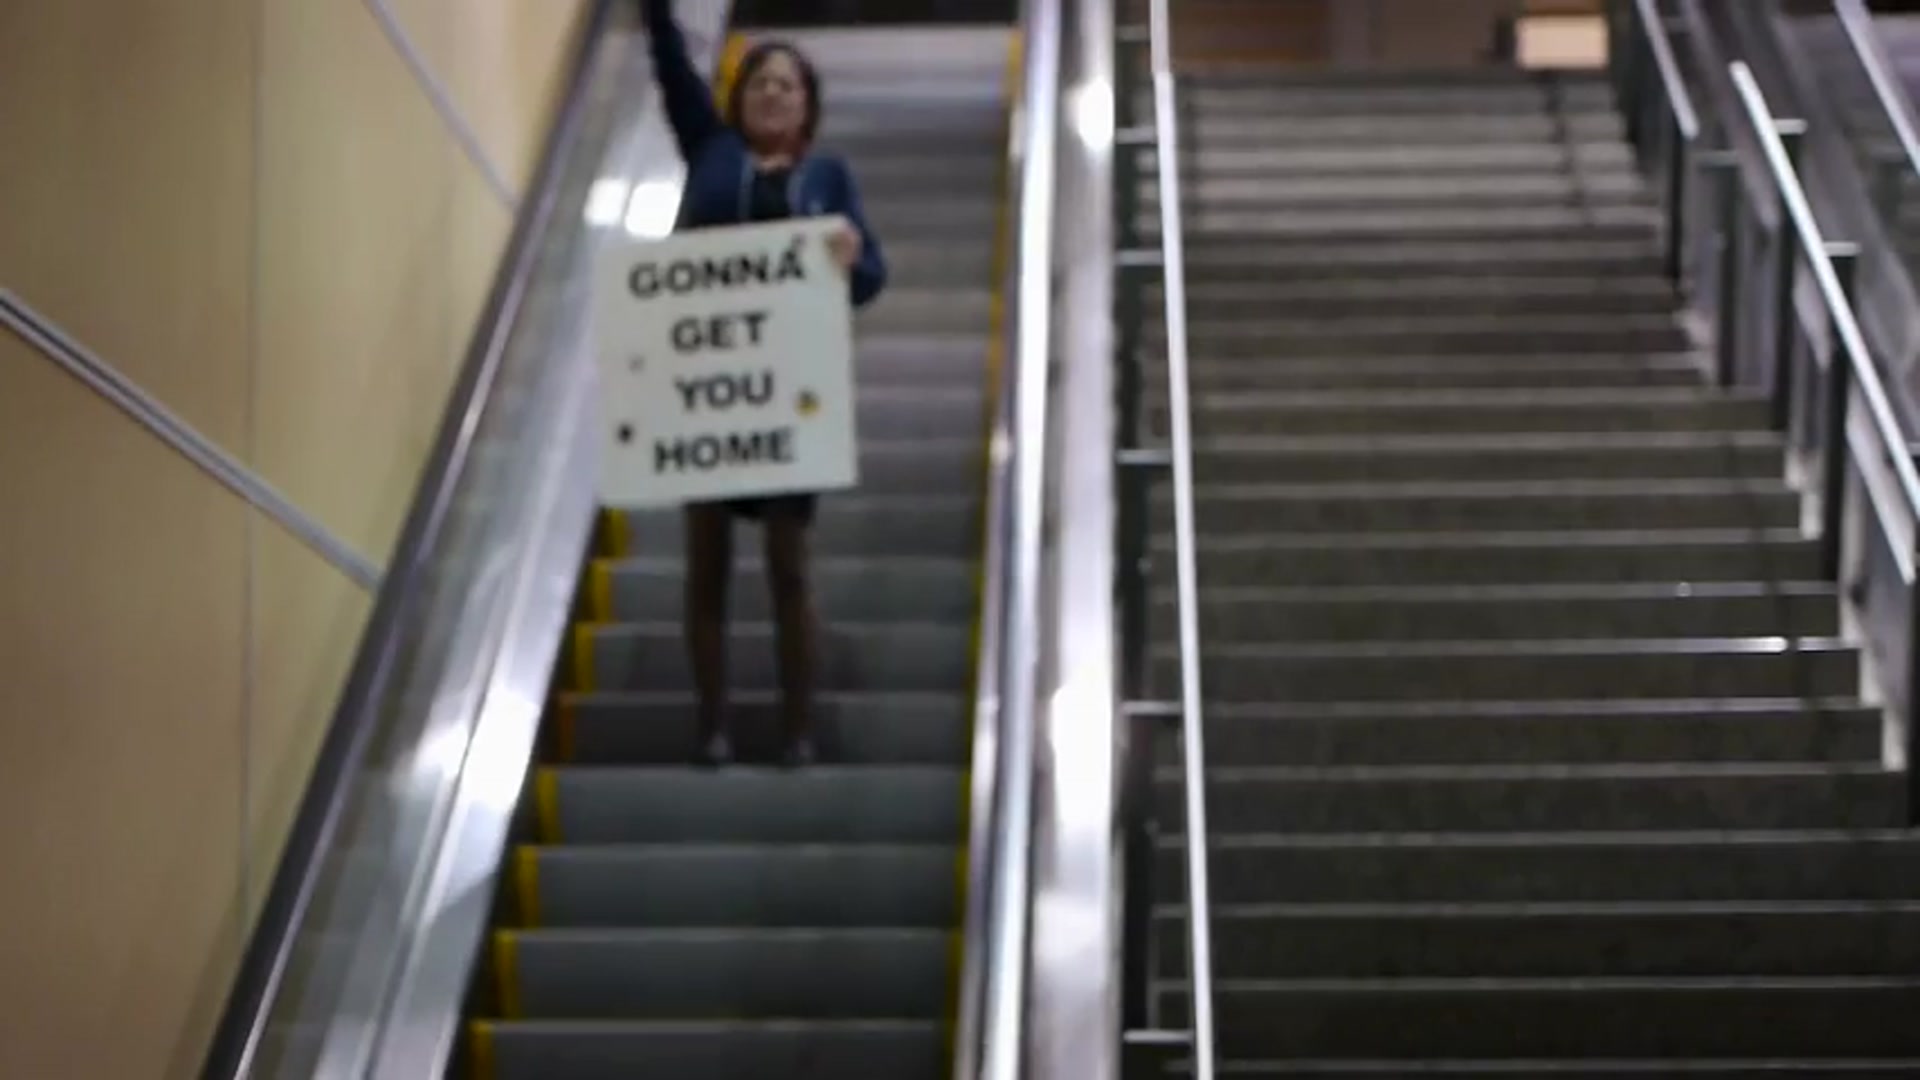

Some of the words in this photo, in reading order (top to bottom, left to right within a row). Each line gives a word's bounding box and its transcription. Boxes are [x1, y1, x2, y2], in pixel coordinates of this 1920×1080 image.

[629, 247, 805, 298] GONNA
[671, 311, 767, 351] GET
[674, 371, 774, 409] YOU
[655, 428, 795, 474] HOME
